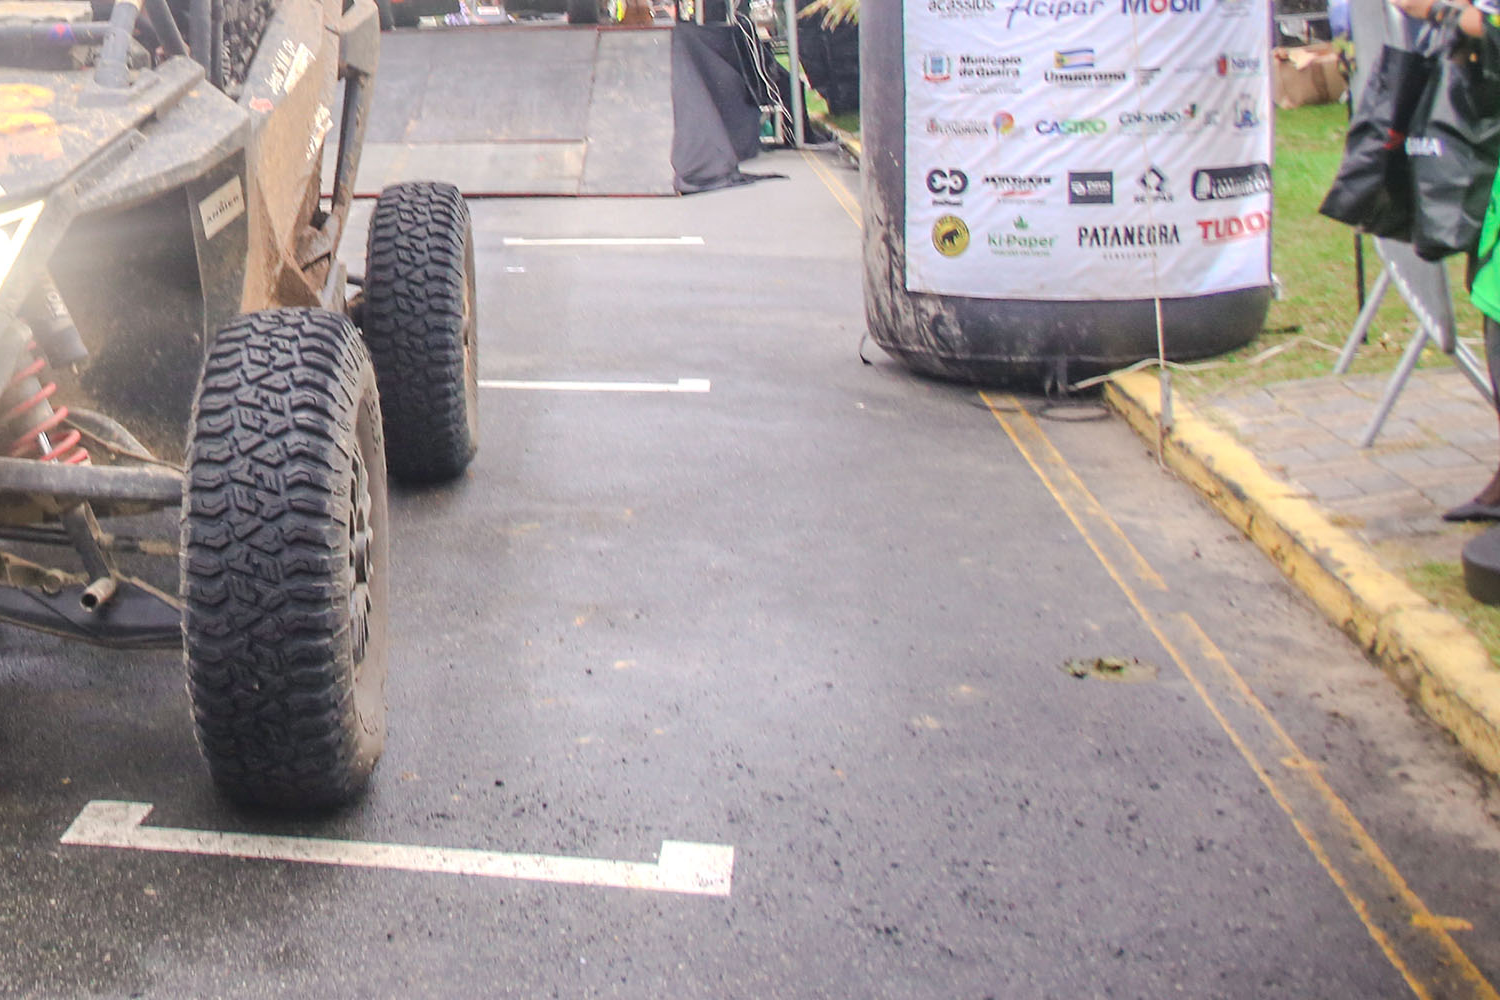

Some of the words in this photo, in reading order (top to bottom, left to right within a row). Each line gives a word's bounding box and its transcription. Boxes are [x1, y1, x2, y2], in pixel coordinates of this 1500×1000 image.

[1035, 119, 1108, 135] CASTRO
[1077, 224, 1181, 248] PATANEGRA
[1196, 210, 1270, 241] TUDO
